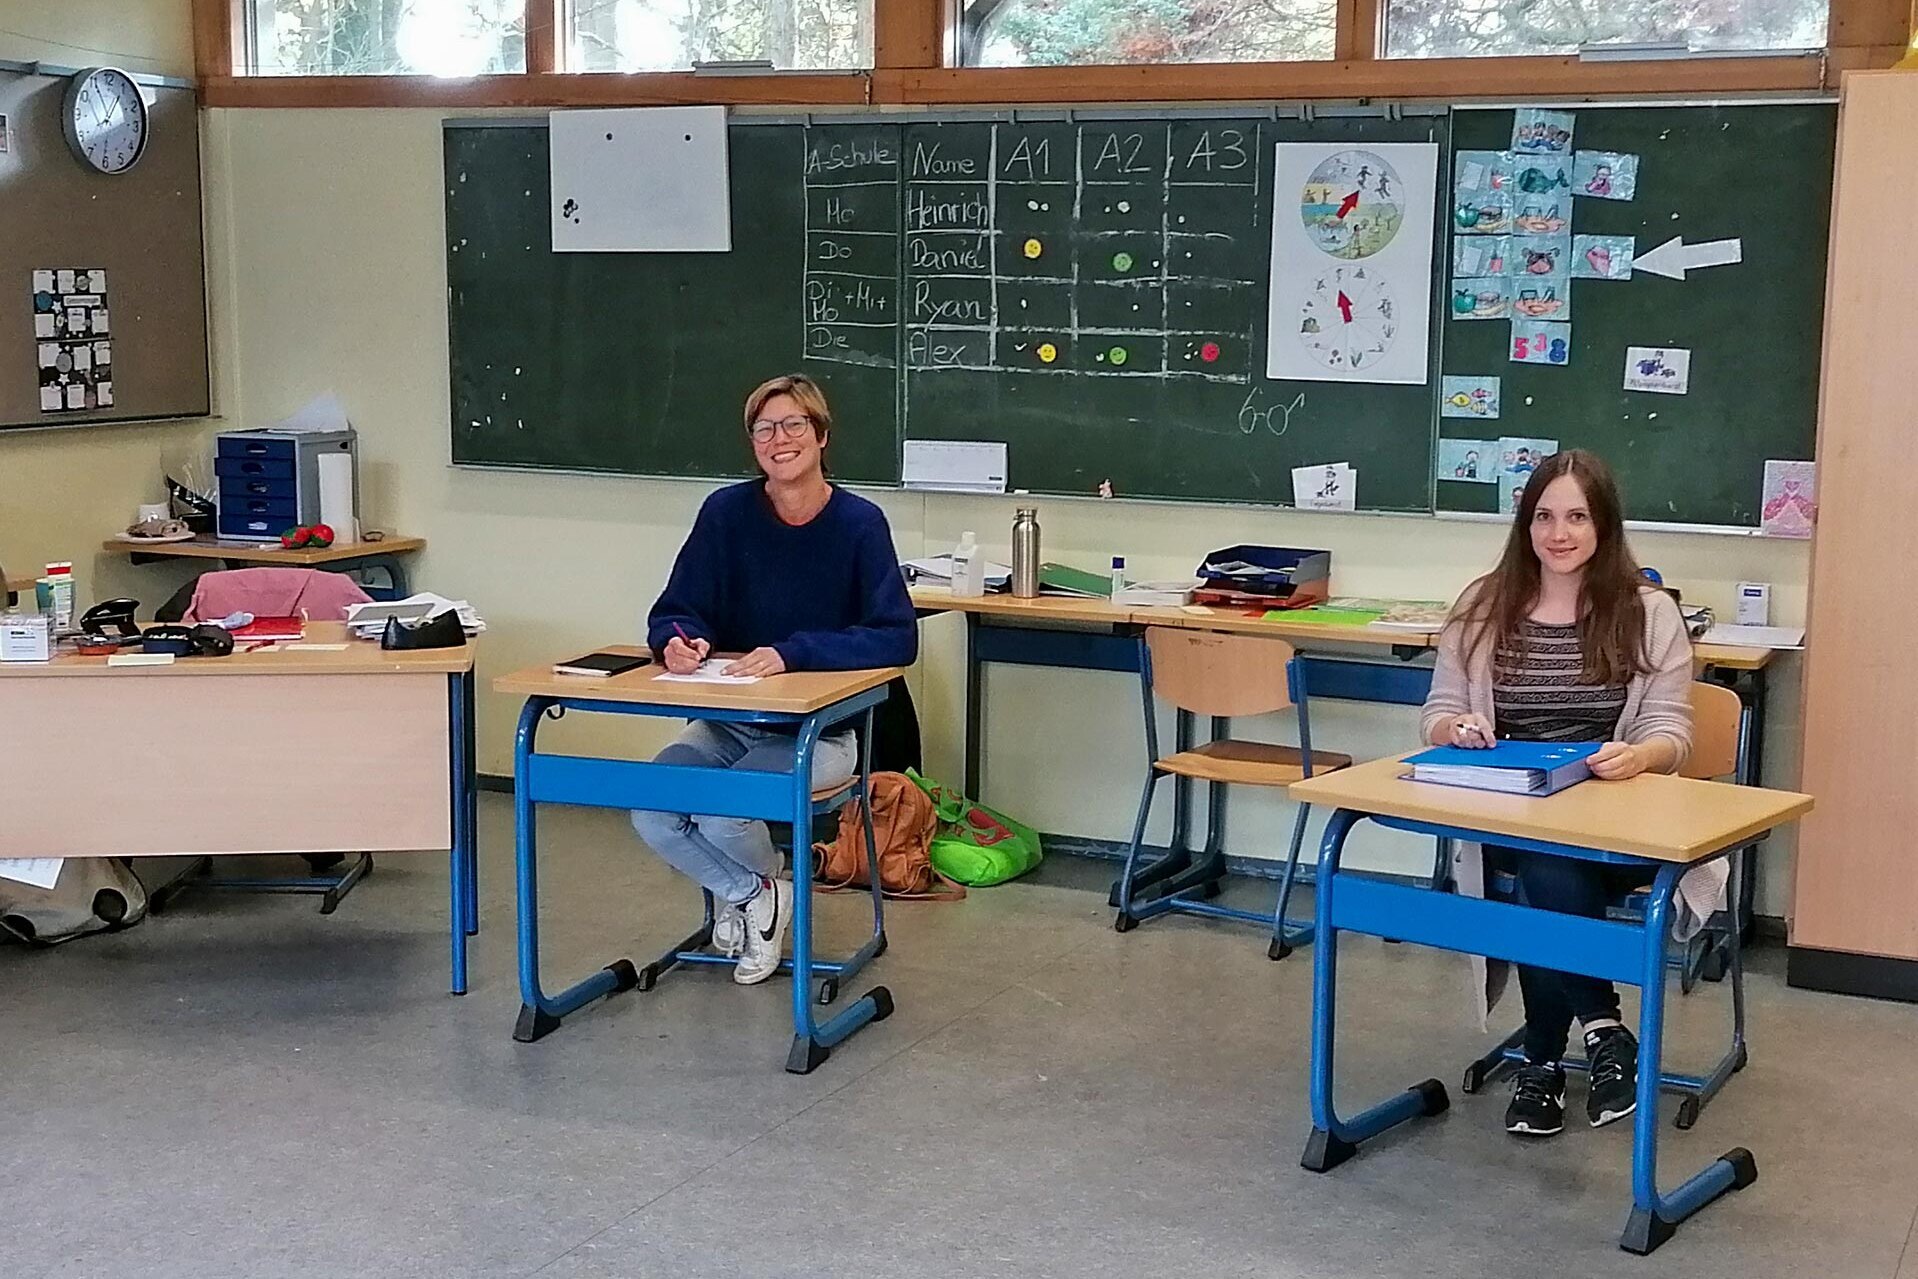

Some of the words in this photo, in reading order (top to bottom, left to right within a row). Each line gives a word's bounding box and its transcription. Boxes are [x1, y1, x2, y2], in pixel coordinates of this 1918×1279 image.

[104, 73, 115, 86] 12
[130, 100, 138, 113] 2
[132, 120, 139, 133] 3
[87, 146, 94, 159] 7
[127, 141, 134, 153] 4
[1004, 136, 1049, 179] A1
[1094, 132, 1151, 173] A2
[1186, 129, 1248, 171] A3
[102, 156, 109, 169] 6
[117, 152, 125, 165] 5
[912, 141, 976, 177] Name
[826, 197, 856, 225] Mo
[907, 188, 988, 230] Heinrich
[818, 240, 852, 260] Do
[909, 233, 986, 271] Daniel
[812, 299, 839, 321] Mo
[914, 280, 987, 332] Ryan
[810, 327, 850, 348] Die
[909, 332, 967, 364] Alex
